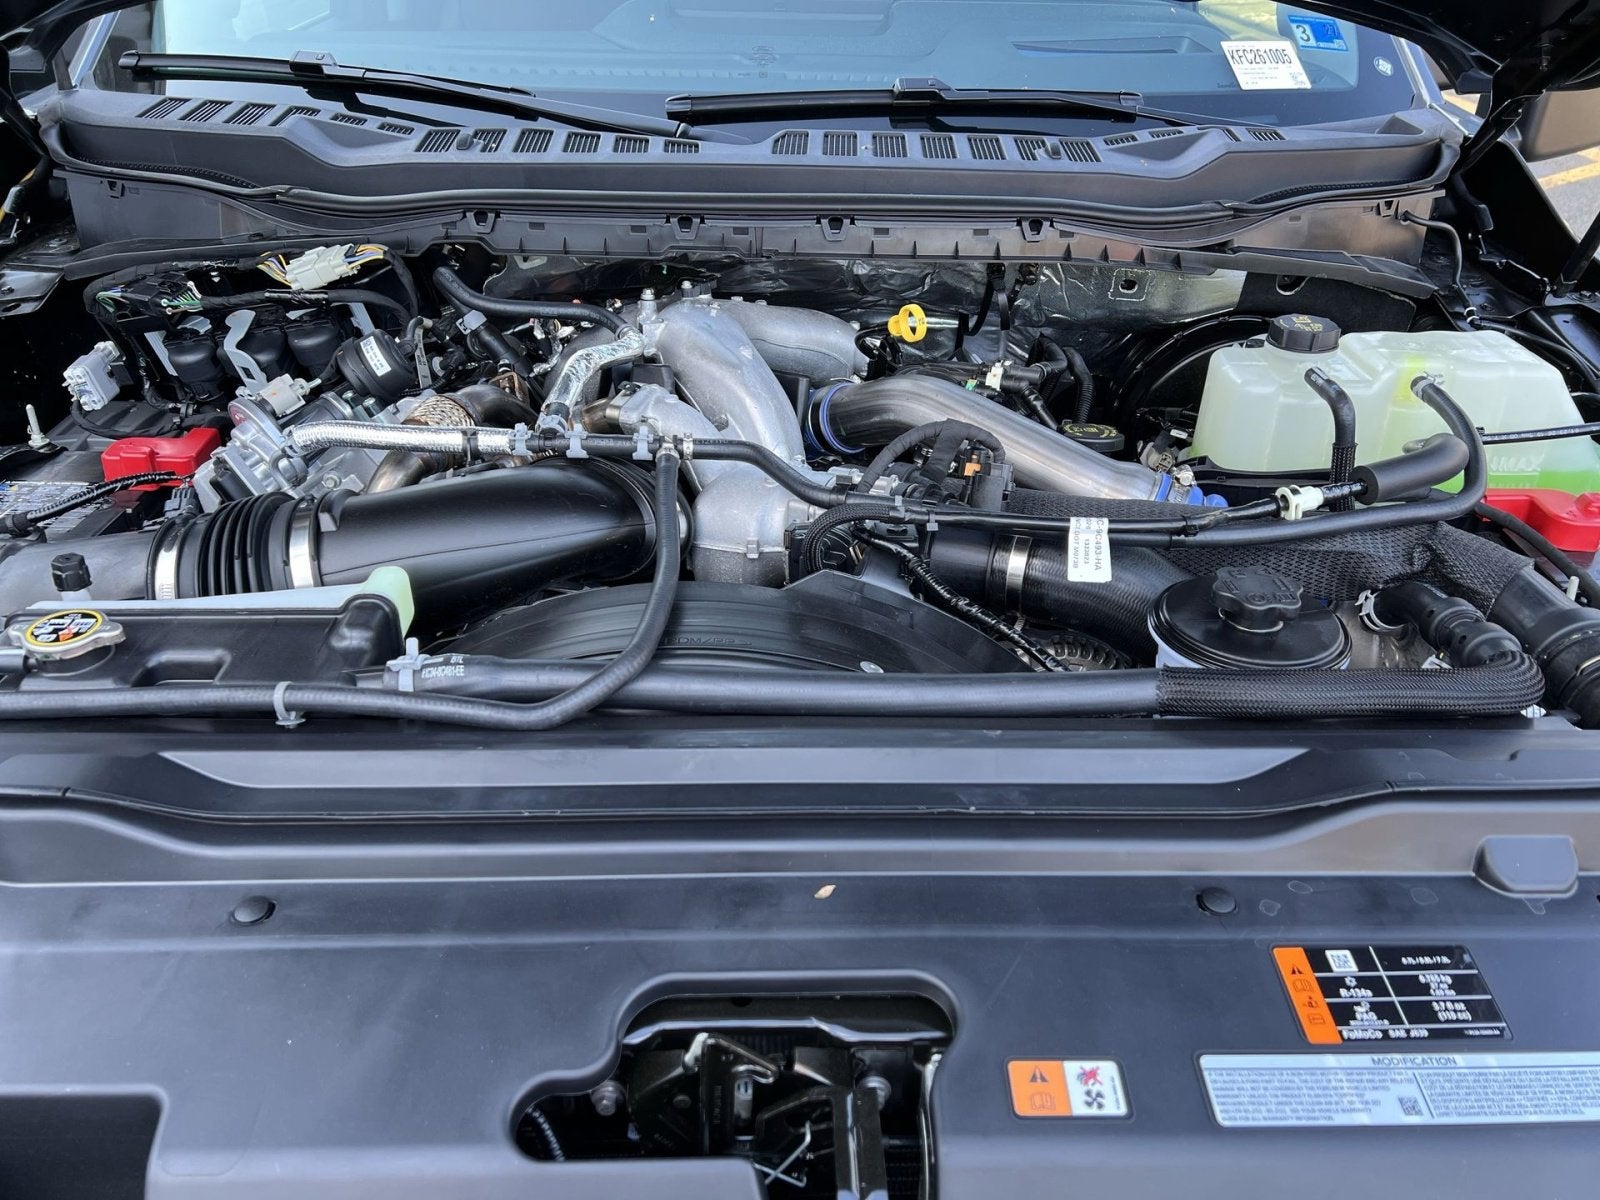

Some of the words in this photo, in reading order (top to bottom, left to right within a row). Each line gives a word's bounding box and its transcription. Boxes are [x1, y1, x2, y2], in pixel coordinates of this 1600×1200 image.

[1295, 24, 1311, 42] 3
[1228, 47, 1292, 65] KFC261005
[1371, 1055, 1457, 1068] MODIFICATION
